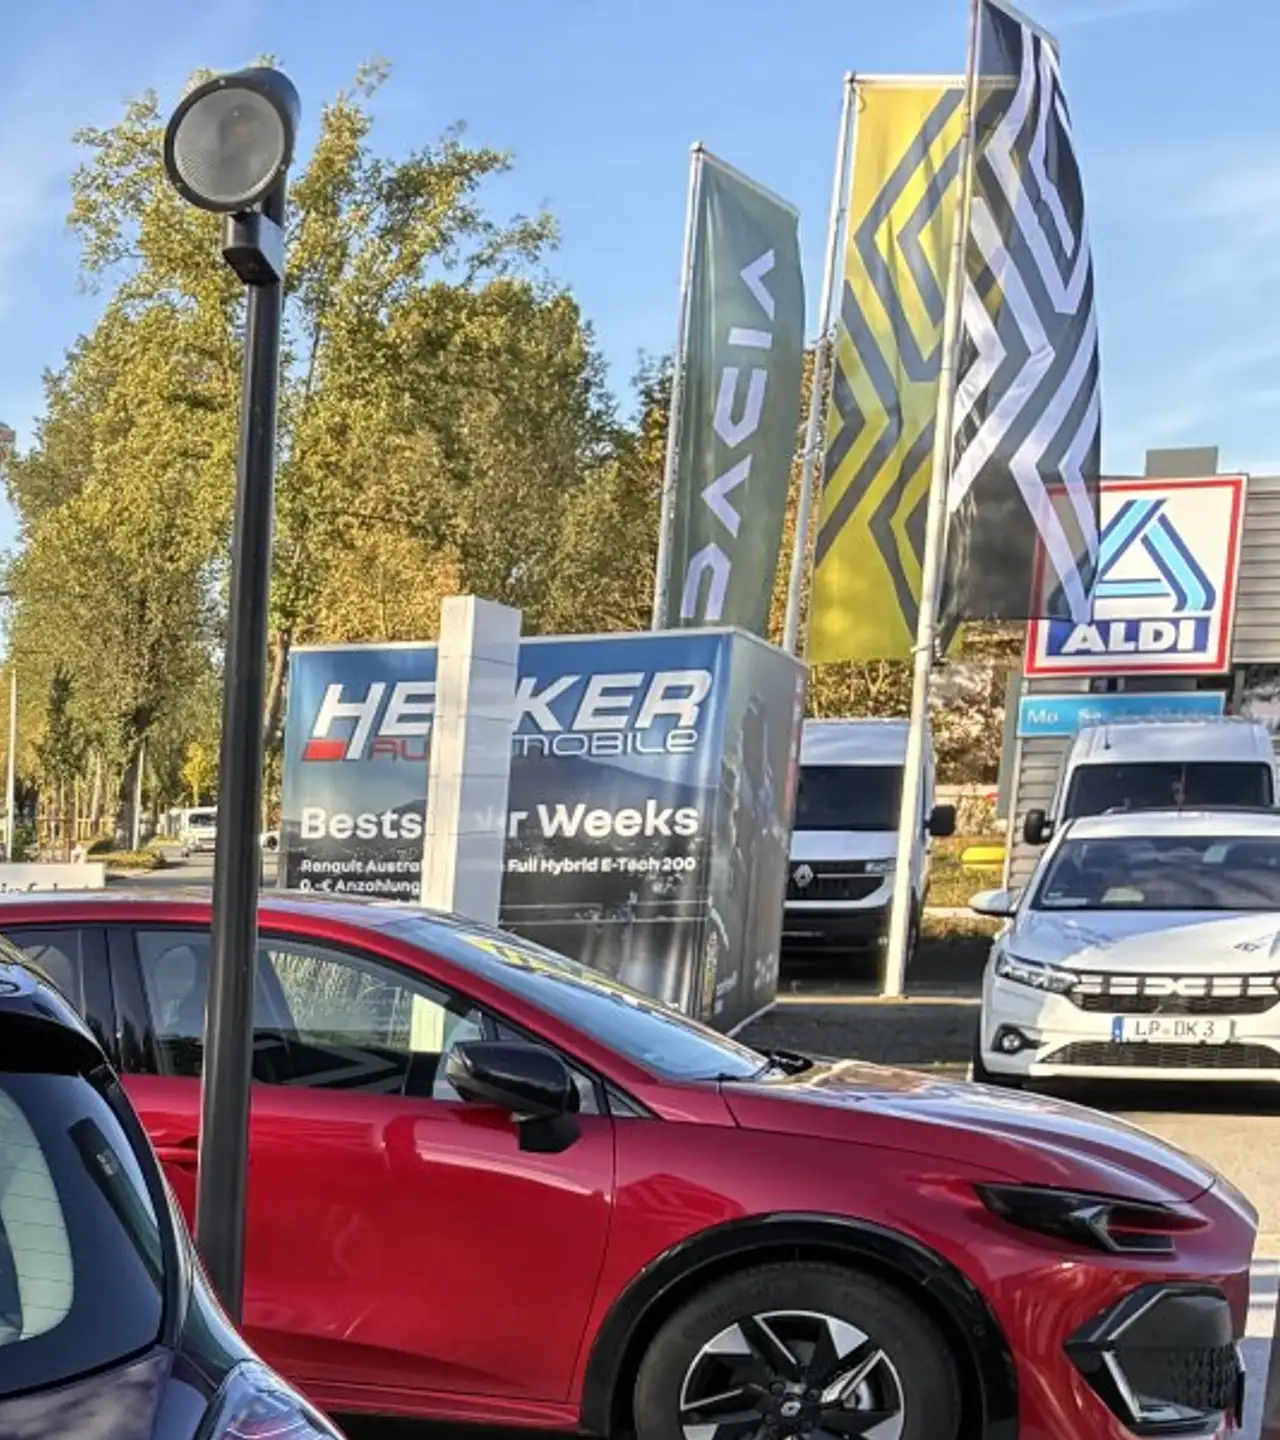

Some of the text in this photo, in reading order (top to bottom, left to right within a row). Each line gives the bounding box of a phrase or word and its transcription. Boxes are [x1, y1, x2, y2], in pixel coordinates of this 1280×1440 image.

[680, 248, 776, 622] DACIA
[1060, 620, 1197, 653] ALDI
[310, 669, 712, 760] HEKER
[300, 799, 700, 839] Bestsr Weeks
[507, 855, 538, 873] Full
[541, 855, 598, 875] Hybrid
[601, 857, 659, 873] E-Tech
[662, 856, 697, 872] 200
[1135, 1019, 1161, 1037] LP
[1202, 1019, 1215, 1037] 3
